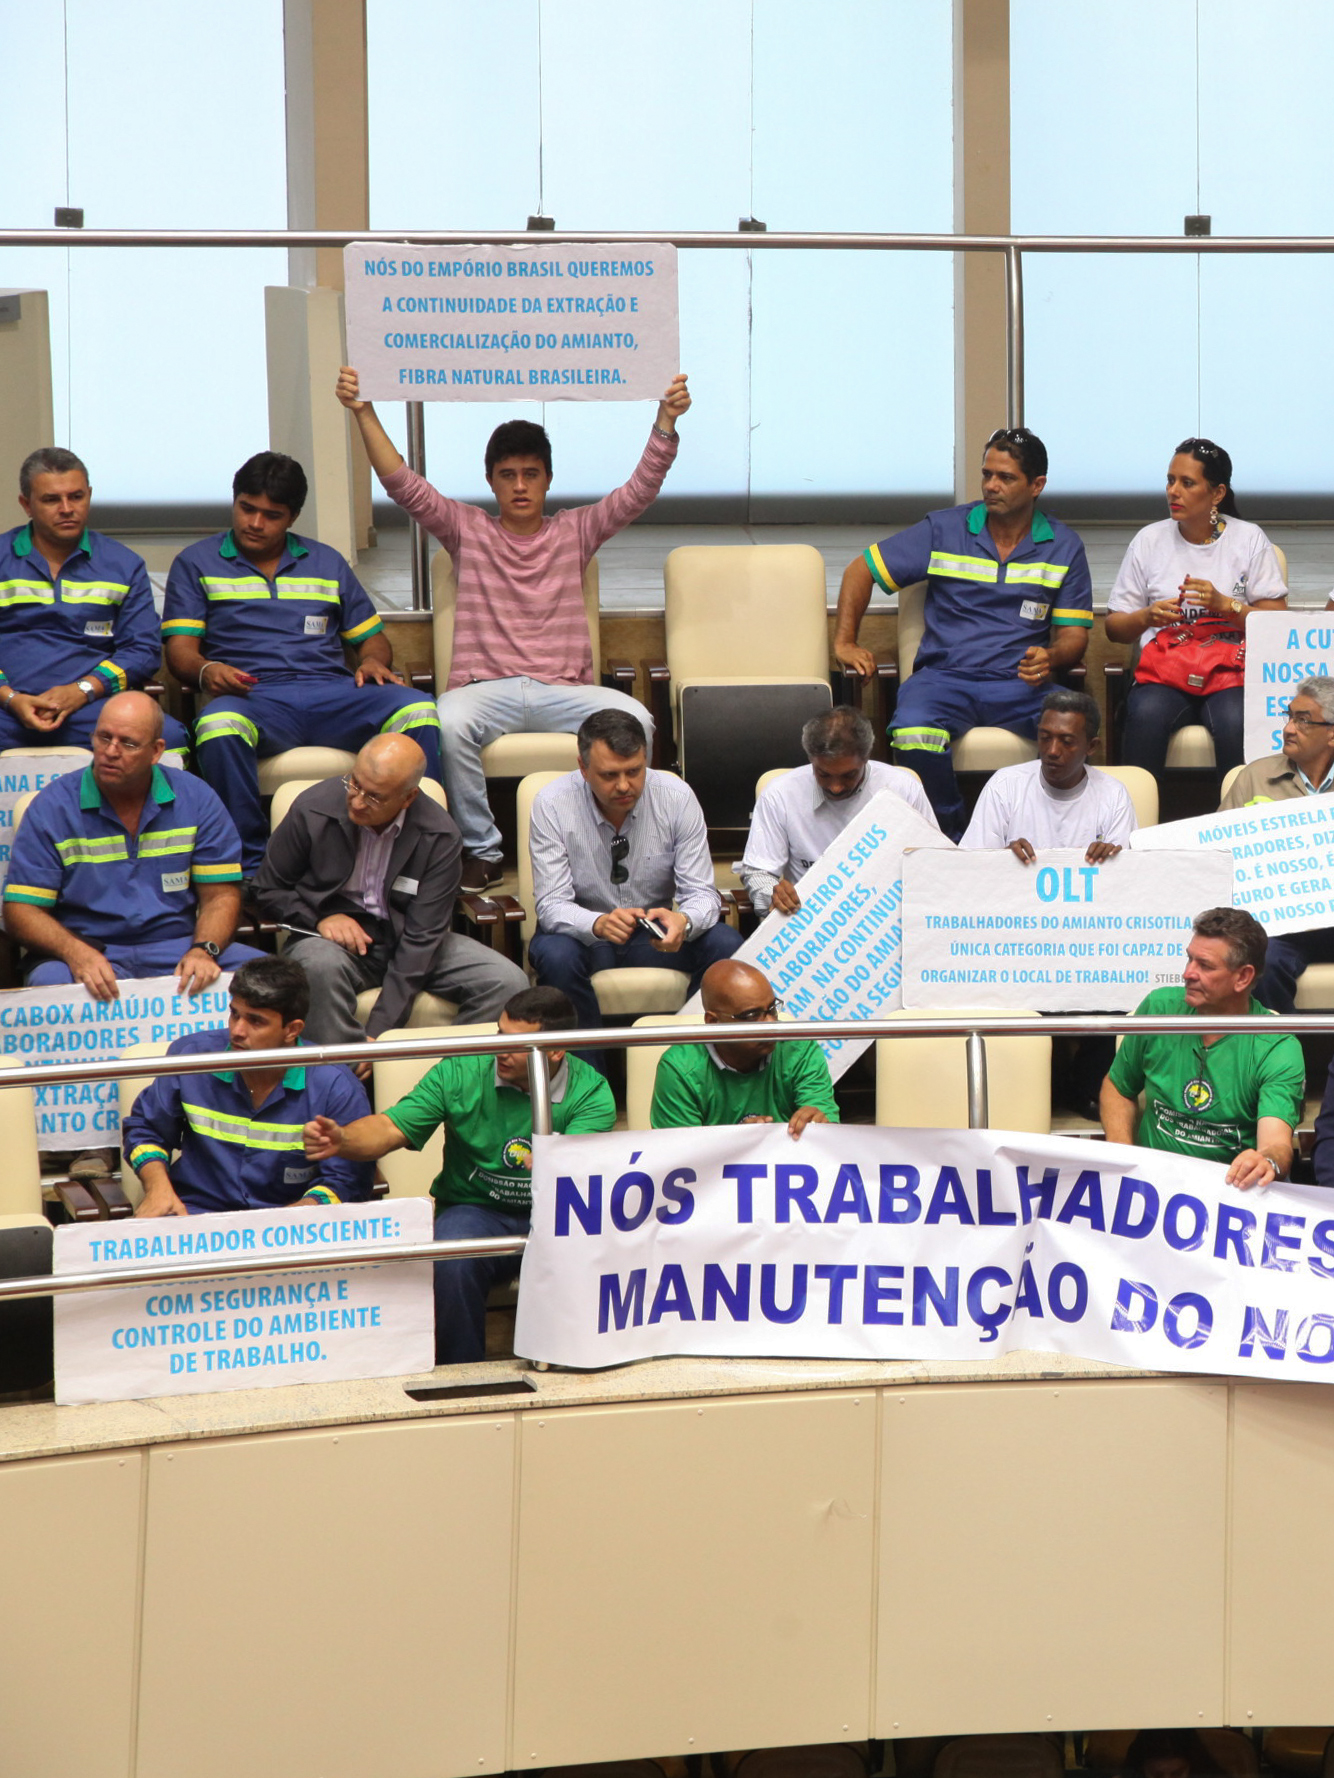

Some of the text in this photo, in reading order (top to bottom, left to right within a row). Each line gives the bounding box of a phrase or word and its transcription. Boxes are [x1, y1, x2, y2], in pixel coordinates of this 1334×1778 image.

[365, 257, 654, 278] NÓS DO EMPÓRIO BRASIL QUEREMOS
[383, 294, 637, 317] A CONTINUIDADE DA EXTRAÇÃO E
[385, 331, 637, 351] COMERCIALIZAÇÃO DO AMIANTO,
[400, 369, 626, 384] FIBRA NATURAL BRASILEIRA.
[1287, 629, 1299, 649] A
[1263, 663, 1328, 683] NOSSA
[1200, 821, 1258, 843] MÓVEIS
[1260, 809, 1327, 831] ESTRELA
[1232, 836, 1310, 859] RADORES,
[1255, 862, 1264, 879] É
[1267, 856, 1324, 879] NOSSO,
[755, 874, 844, 970] FAZENDEIRO
[837, 862, 855, 878] E
[848, 823, 888, 868] SEUS
[1037, 867, 1099, 902] OLT
[1233, 886, 1274, 906] GURO
[1277, 884, 1287, 897] E
[1291, 877, 1331, 894] GERA
[926, 916, 1038, 929] TRABALHADORES
[1041, 916, 1059, 929] DO
[1063, 917, 1122, 929] AMIANTO
[1274, 901, 1325, 920] NOSSO
[770, 883, 878, 997] LABORADORES,
[951, 940, 1182, 957] ÚNICA CATEGORIA QUE FOI CAPAZ DE
[811, 961, 840, 989] NA
[844, 964, 871, 992] DO
[922, 970, 997, 983] ORGANIZAR
[1000, 970, 1009, 983] O
[1014, 970, 1052, 983] LOCAL
[1056, 970, 1071, 983] DE
[1076, 970, 1148, 983] TRABALHO!
[81, 994, 165, 1023] ARAÚJO
[173, 996, 181, 1015] E
[189, 992, 227, 1014] SEU
[4, 1027, 140, 1054] BORADORES
[554, 1152, 699, 1238] NÓS
[89, 1218, 400, 1261] TRABALHADOR CONSCIENTE:
[146, 1280, 348, 1316] COM SEGURANÇA E
[598, 1242, 1090, 1343] MANUTENÇÃO
[1109, 1278, 1214, 1350] DO
[112, 1304, 380, 1349] CONTROLE DO AMBIENTE
[171, 1341, 327, 1373] DE TRABALHO.
